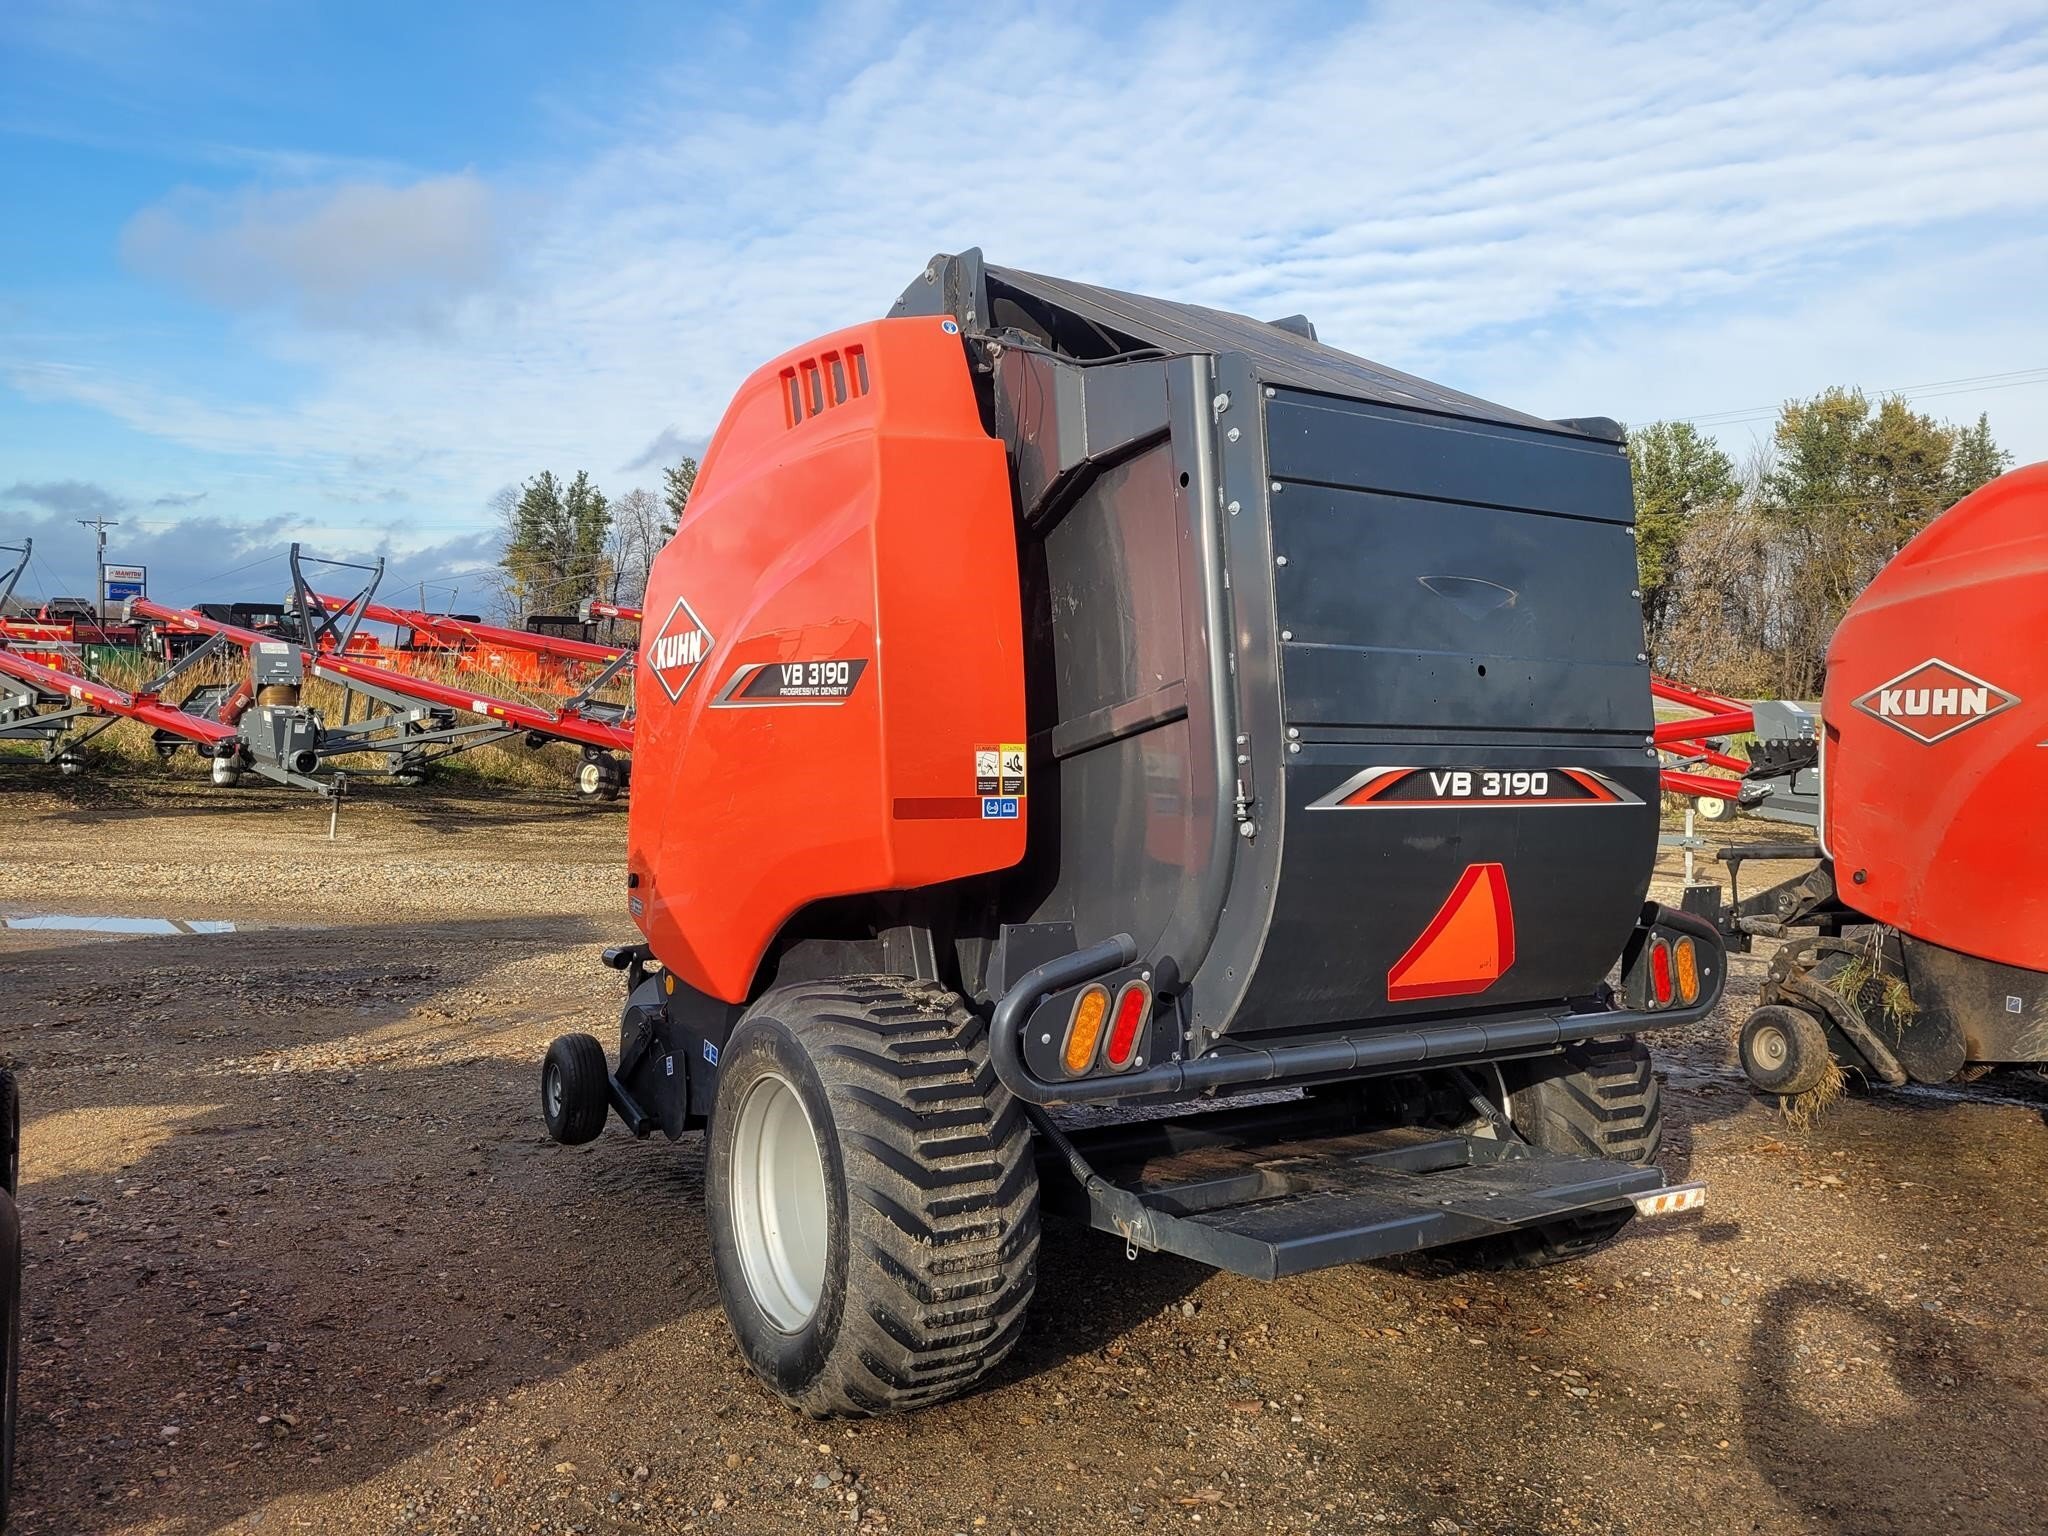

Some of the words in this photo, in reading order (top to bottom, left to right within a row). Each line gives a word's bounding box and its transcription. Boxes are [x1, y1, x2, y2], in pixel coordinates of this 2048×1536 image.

[656, 629, 702, 670] KUHN
[781, 664, 803, 686] VB
[808, 662, 849, 685] 3190
[779, 687, 820, 696] PROGRESSIVE
[820, 685, 848, 696] DENSITY
[1879, 688, 1988, 716] KUHN
[1429, 772, 1472, 797] VB
[1482, 772, 1549, 796] 3190
